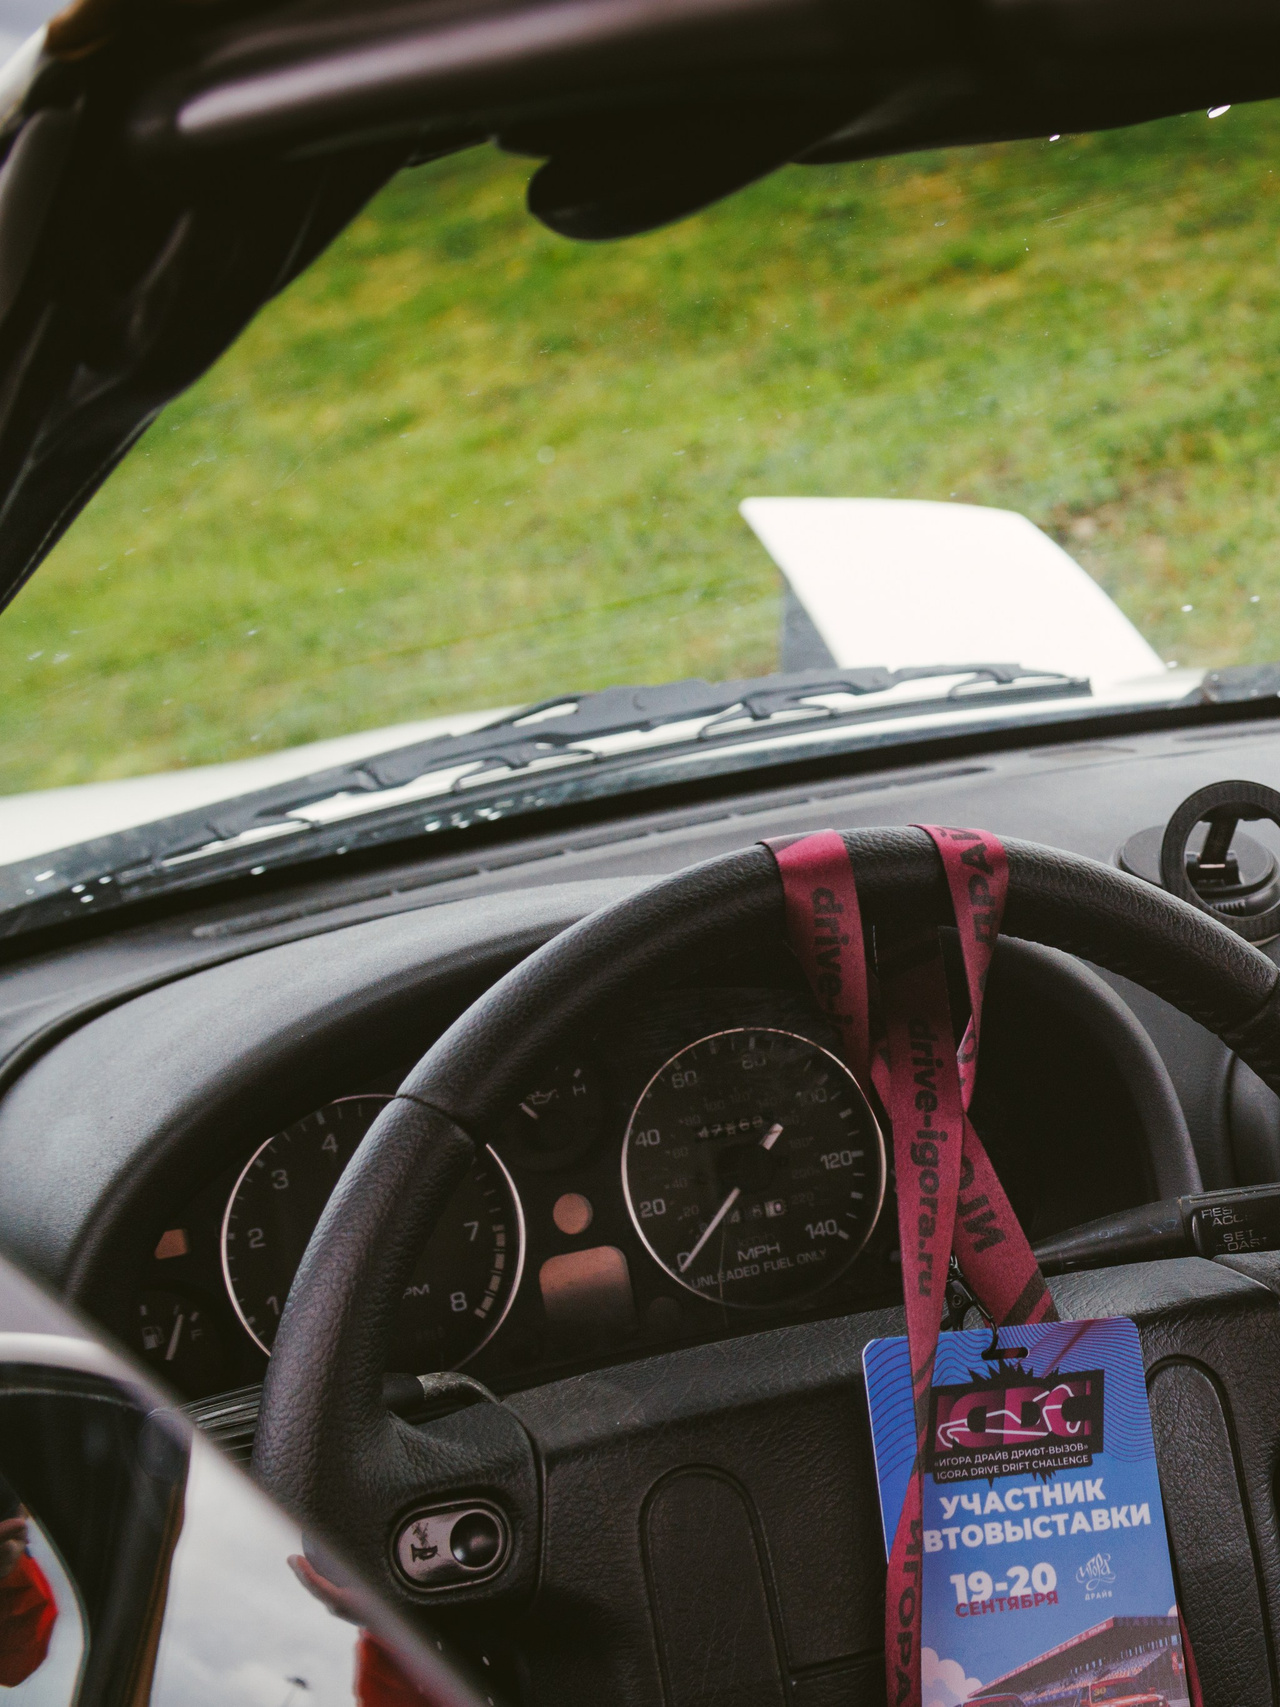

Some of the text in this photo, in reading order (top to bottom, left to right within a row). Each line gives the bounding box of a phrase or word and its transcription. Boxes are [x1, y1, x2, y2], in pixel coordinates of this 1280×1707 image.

[941, 826, 997, 948] ДРАЙ
[671, 1069, 698, 1089] 60
[320, 1132, 340, 1155] 4
[635, 1128, 661, 1148] 40
[820, 1150, 852, 1170] 120
[907, 1017, 949, 1297] drive-igora.ru
[270, 1169, 290, 1190] 3
[639, 1198, 667, 1219] 20
[1201, 1206, 1233, 1220] RES
[247, 1227, 266, 1250] 2
[462, 1220, 480, 1242] 7
[805, 1219, 837, 1240] 140
[1222, 1229, 1254, 1243] SET
[737, 1242, 781, 1262] MPH
[690, 1248, 827, 1290] UNLEADED FUEL ONLY
[402, 1282, 431, 1299] PM
[265, 1294, 281, 1316] 1
[449, 1291, 468, 1313] 8
[936, 1454, 1089, 1480] IGORA DRIVE DRIFT CHALLENGE
[974, 1449, 1009, 1464] ДРАЙВ
[939, 1477, 1106, 1520] УЧАСТНИК
[922, 1502, 1152, 1553] ВТОВЫСТАВКИ
[949, 1561, 1058, 1606] 19-20
[955, 1589, 1059, 1618] СЕНТЯБРЯ
